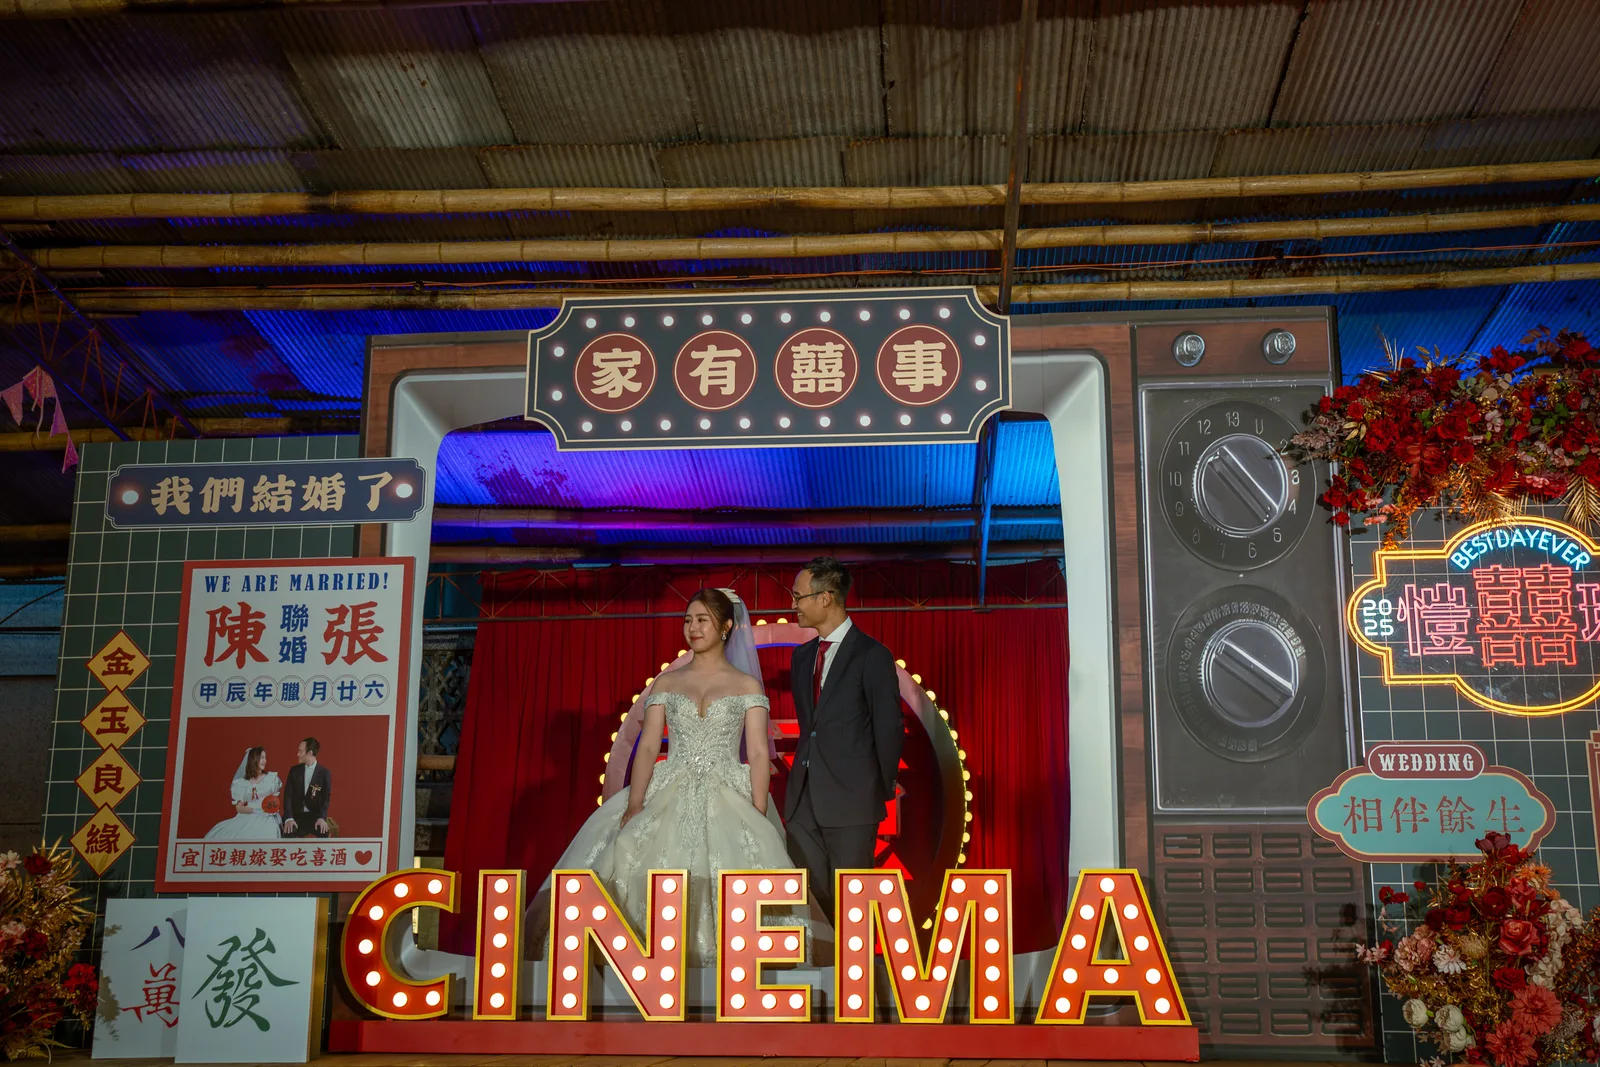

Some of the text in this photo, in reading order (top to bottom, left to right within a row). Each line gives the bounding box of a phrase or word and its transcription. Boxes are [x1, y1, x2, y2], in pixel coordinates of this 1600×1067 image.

[590, 340, 948, 399] 家有囍事
[1197, 419, 1212, 435] 12
[1225, 411, 1240, 427] 13
[1178, 441, 1190, 456] 11
[1279, 438, 1289, 455] 2
[1168, 471, 1182, 487] 10
[150, 471, 393, 516] 我們結婚了
[1248, 542, 1257, 559] 6
[204, 572, 389, 593] WE ARE MARRIED!
[203, 601, 270, 670] 陳
[278, 604, 309, 665] 聯婚
[320, 600, 389, 666] 張
[199, 680, 386, 702] 甲辰年臘月廿六
[84, 646, 137, 855] 金玉良緣
[1377, 753, 1475, 772] WEDDING
[1343, 795, 1526, 835] 相伴餘生
[181, 848, 348, 868] 宜 迎親嫁娶吃喜酒
[340, 867, 1193, 1026] CINEMA
[190, 927, 301, 1032] 發
